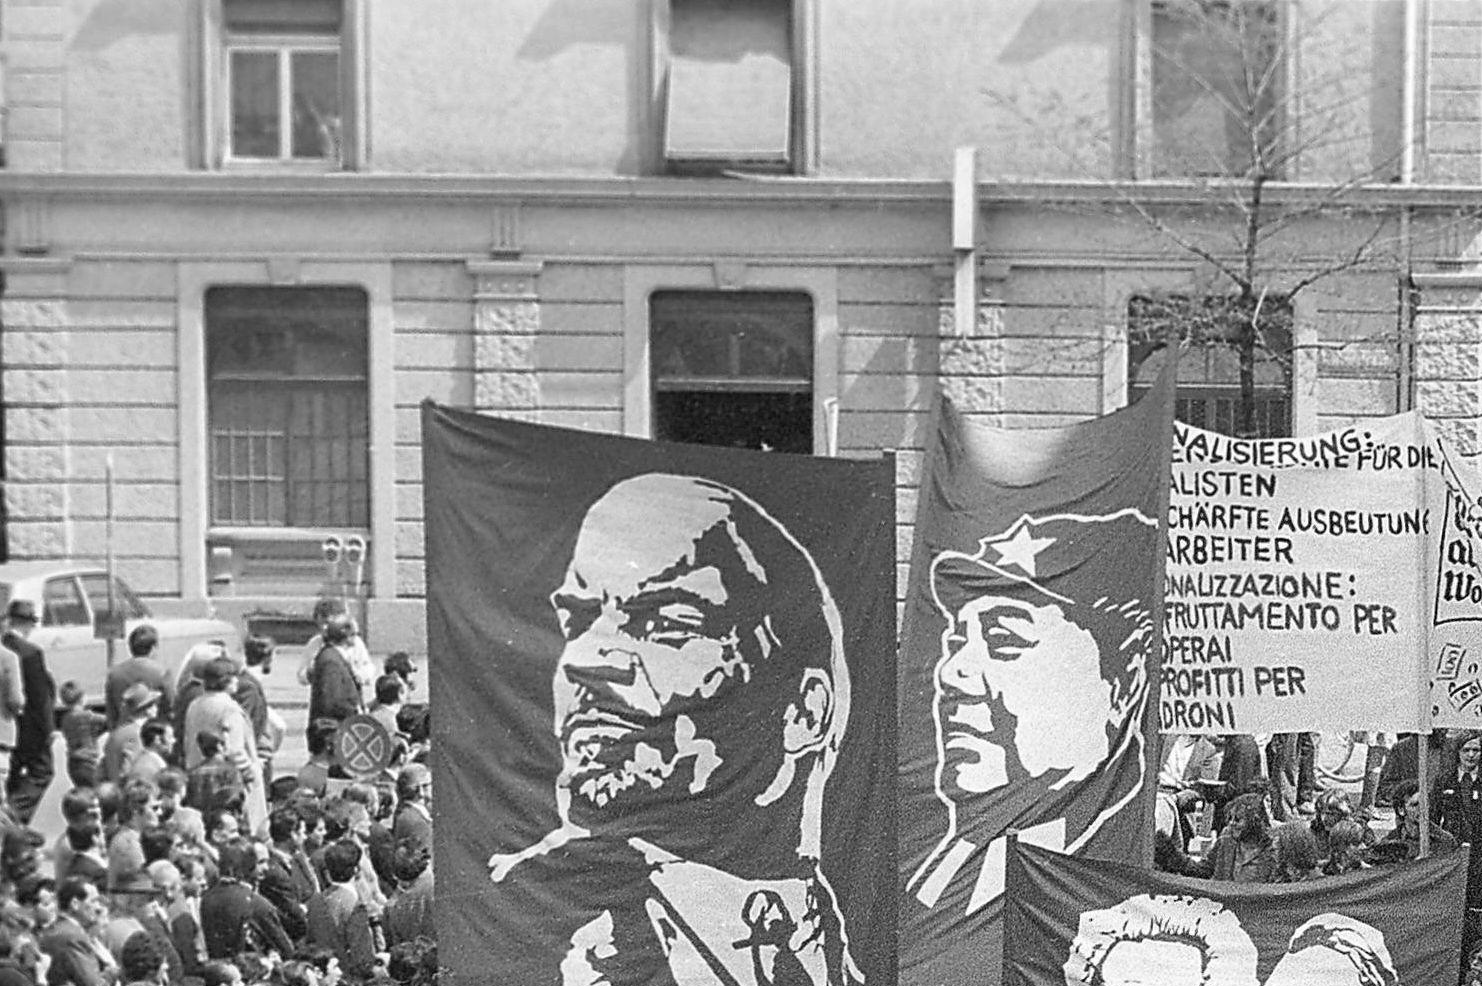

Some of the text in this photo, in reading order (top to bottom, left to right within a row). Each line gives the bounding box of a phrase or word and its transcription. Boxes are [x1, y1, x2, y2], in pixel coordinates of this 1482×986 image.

[1357, 444, 1403, 470] FÜR
[1353, 603, 1398, 635] PER
[1254, 666, 1306, 697] PER
